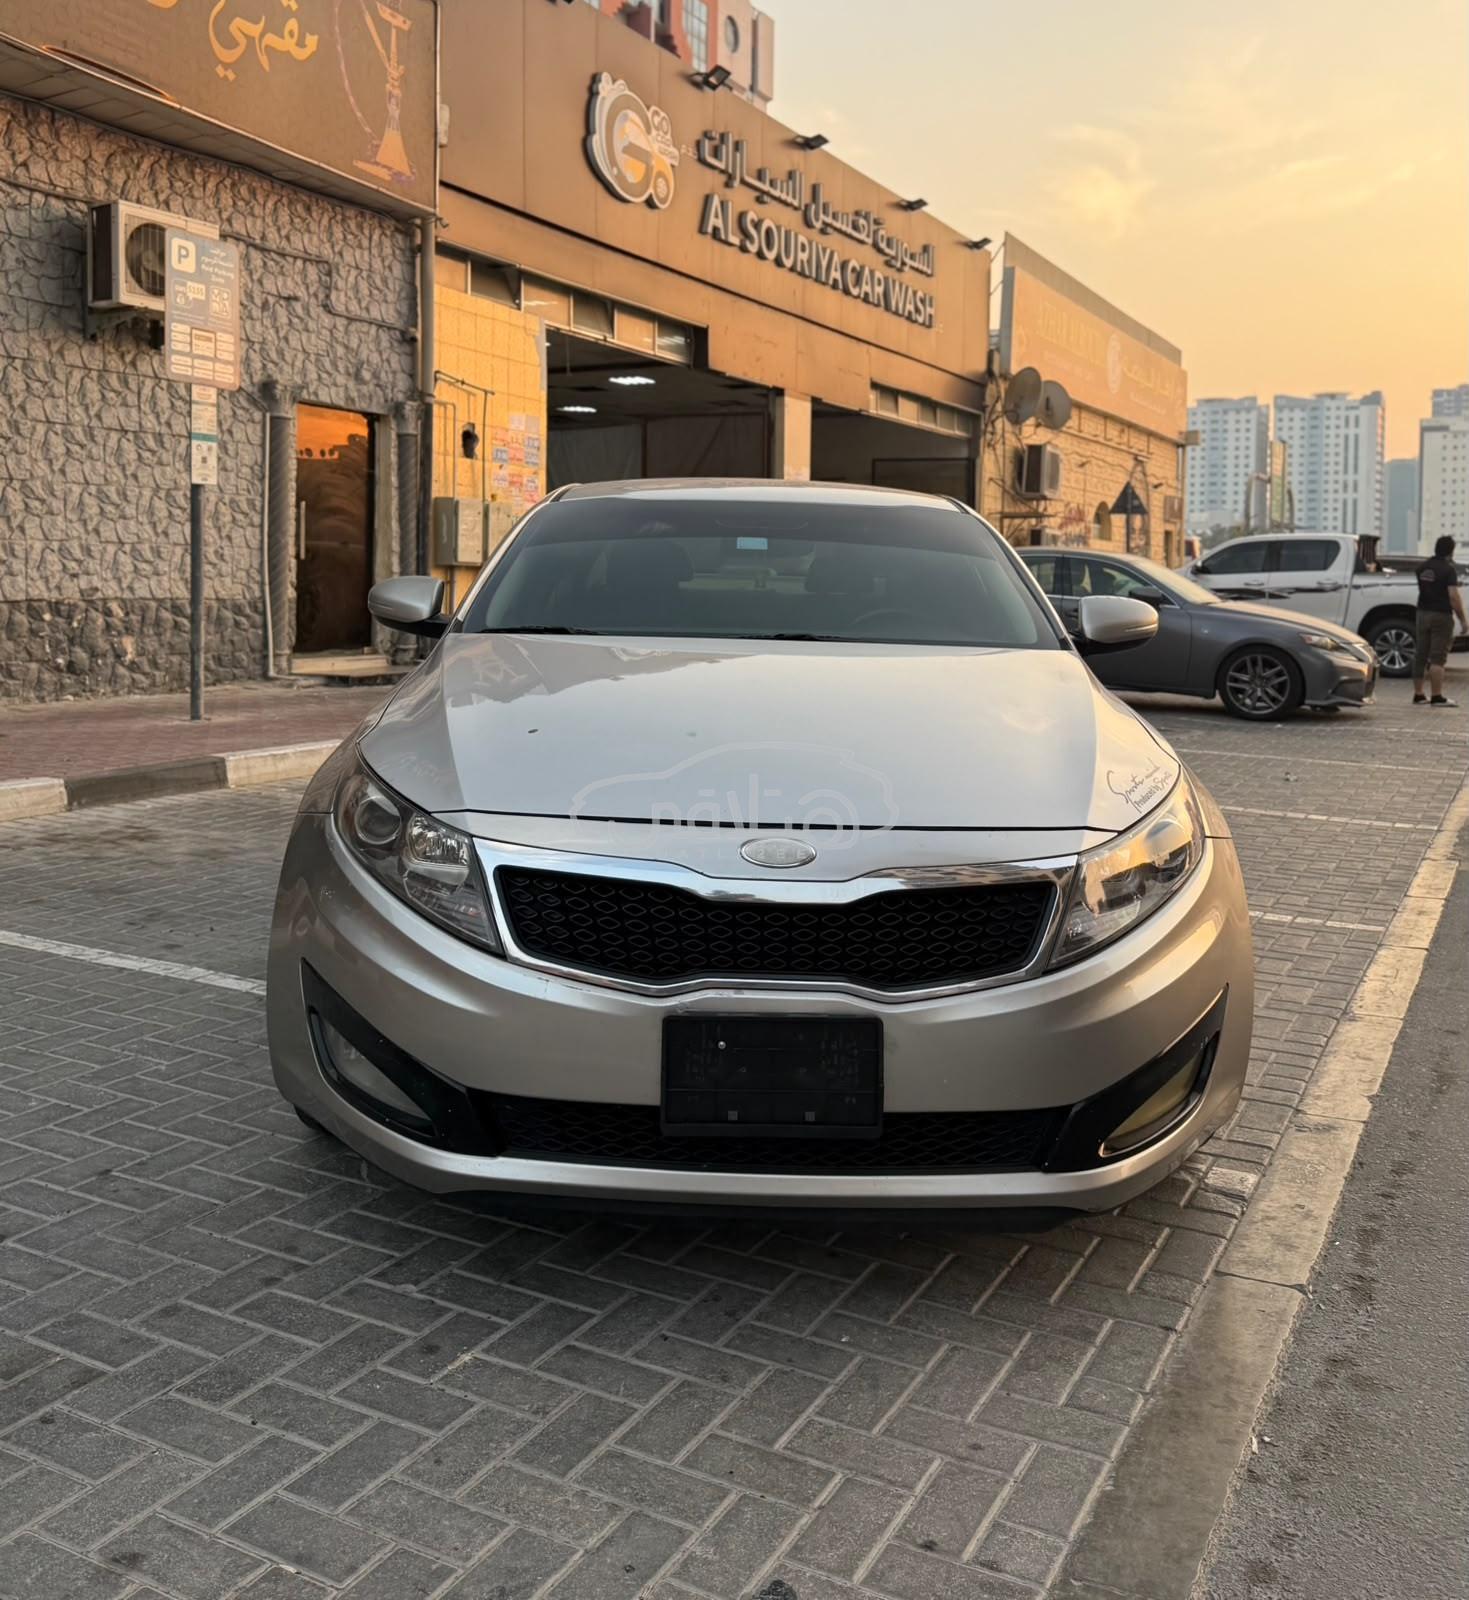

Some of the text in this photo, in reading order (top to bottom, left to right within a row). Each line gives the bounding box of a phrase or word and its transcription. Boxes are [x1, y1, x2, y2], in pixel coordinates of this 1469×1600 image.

[696, 130, 805, 211] السيارات
[177, 244, 190, 265] P
[698, 192, 936, 329] AL SOURIYA CAR WASH
